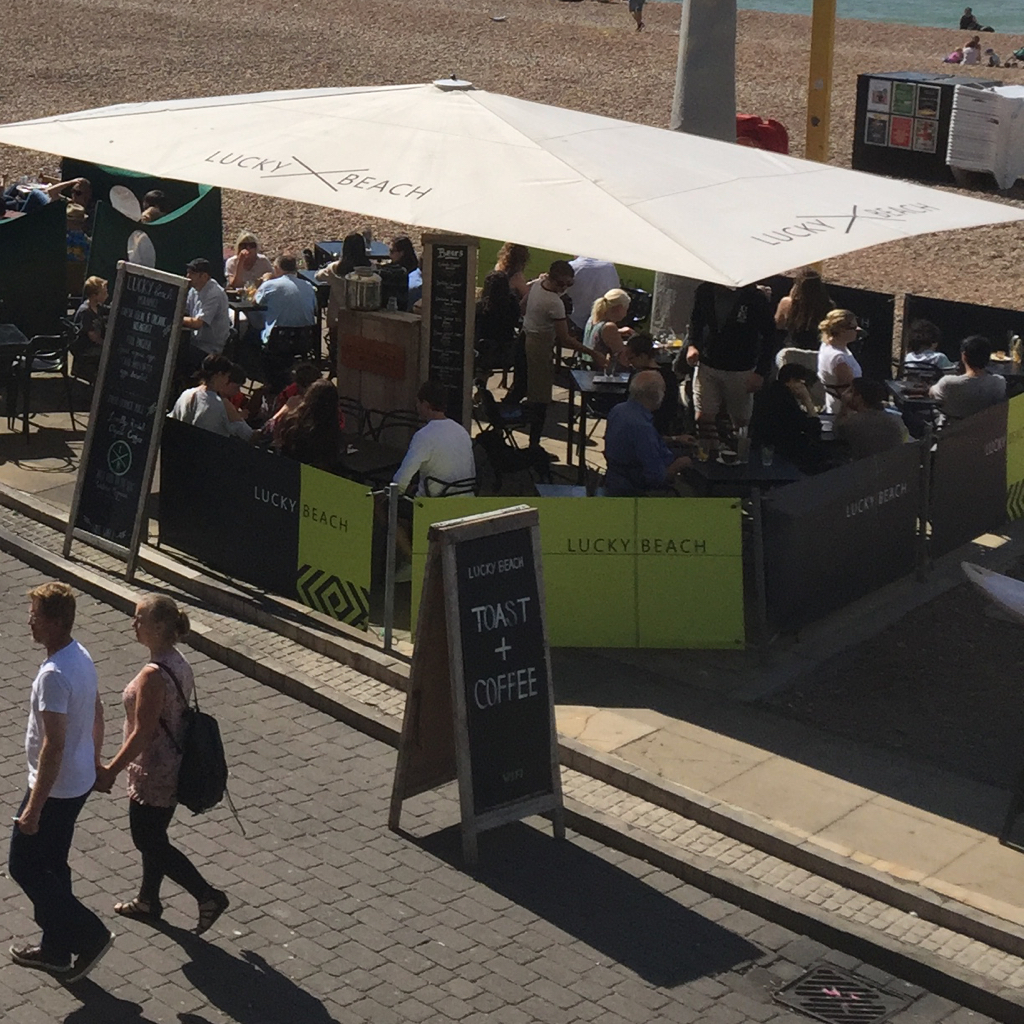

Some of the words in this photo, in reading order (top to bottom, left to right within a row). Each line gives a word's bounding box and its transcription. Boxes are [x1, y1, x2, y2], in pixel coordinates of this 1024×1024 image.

[204, 150, 292, 174] LUCKY
[337, 173, 433, 200] BEACH
[750, 219, 835, 246] LUCKY
[254, 486, 297, 512] LUCKY
[303, 504, 348, 532] BEACH
[846, 495, 875, 518] LUCKY
[878, 482, 907, 505] BEACH
[567, 538, 632, 553] LUCKY
[640, 538, 707, 553] BEACH
[468, 561, 496, 580] LUCKY
[498, 556, 524, 571] BEACH
[471, 596, 531, 633] TOAST
[494, 637, 512, 661] +
[474, 667, 538, 710] COFFEE
